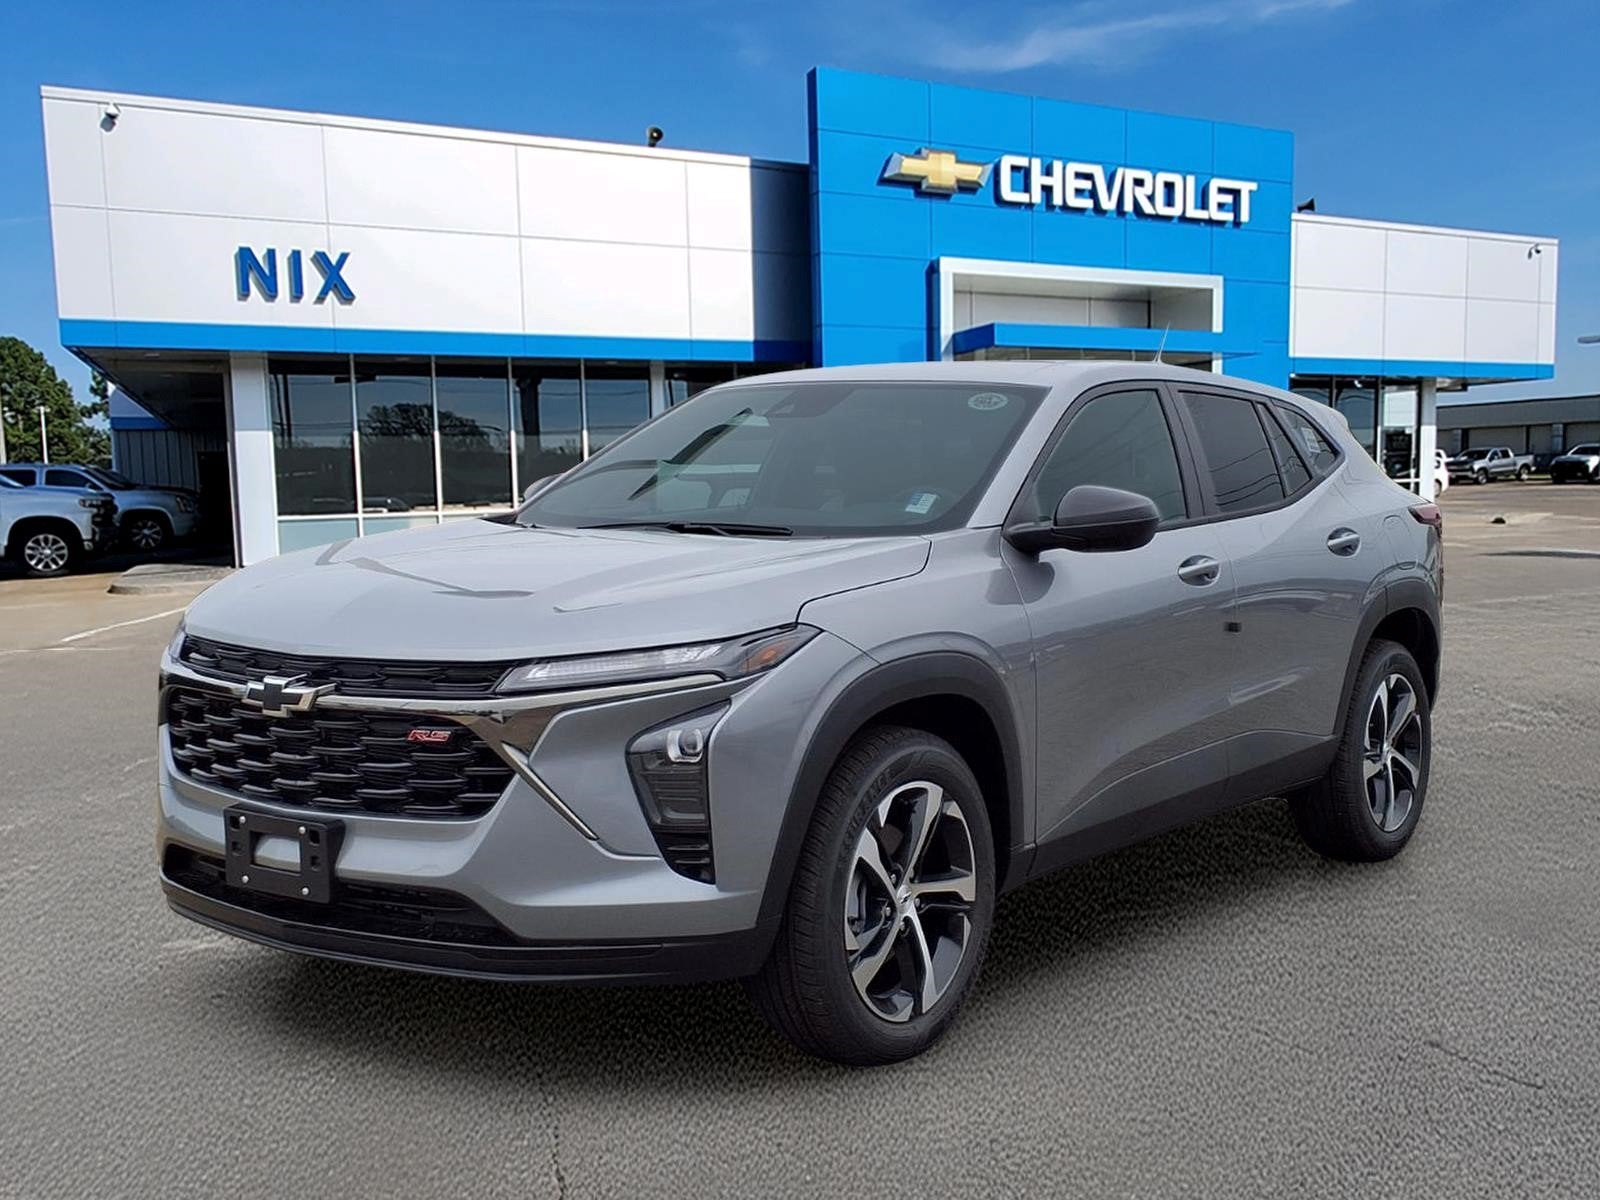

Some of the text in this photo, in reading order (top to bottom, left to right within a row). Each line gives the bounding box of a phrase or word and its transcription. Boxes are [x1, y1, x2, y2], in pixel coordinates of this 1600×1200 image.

[999, 154, 1258, 223] CHEVROLET
[235, 246, 356, 304] NIX
[408, 730, 451, 742] RS
